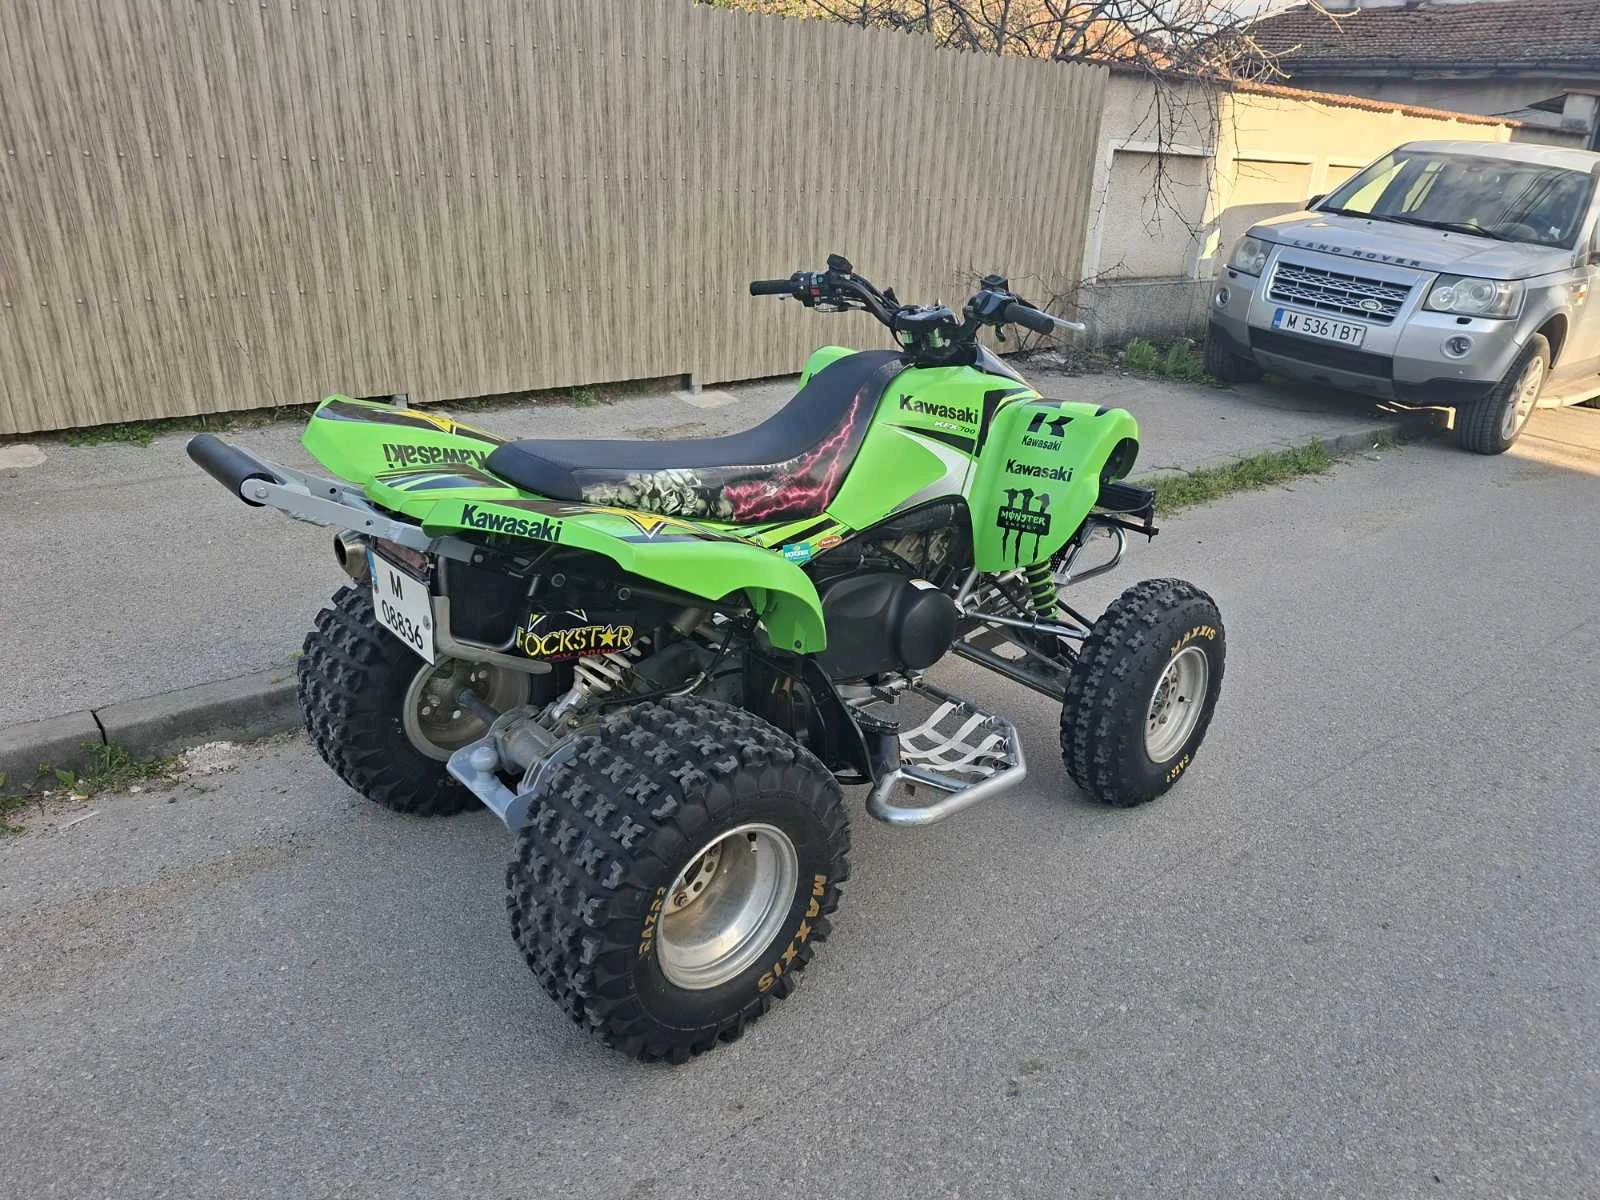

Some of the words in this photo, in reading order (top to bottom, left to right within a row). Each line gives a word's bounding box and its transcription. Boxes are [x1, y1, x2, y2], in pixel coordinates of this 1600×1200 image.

[1294, 240, 1342, 253] LAND
[1352, 251, 1421, 267] ROVER
[1286, 313, 1297, 329] M
[1302, 318, 1362, 343] 5361BT
[899, 393, 979, 424] Kawasaki
[959, 425, 976, 434] 700
[1021, 434, 1062, 451] Kawasaki
[382, 443, 489, 469] Kawasaki
[1005, 458, 1074, 482] Kawasaki
[460, 503, 563, 542] Kawasaki
[1000, 510, 1046, 526] MONSTER
[390, 570, 403, 600] M
[382, 600, 424, 650] 08836
[758, 874, 827, 993] MAXXIS
